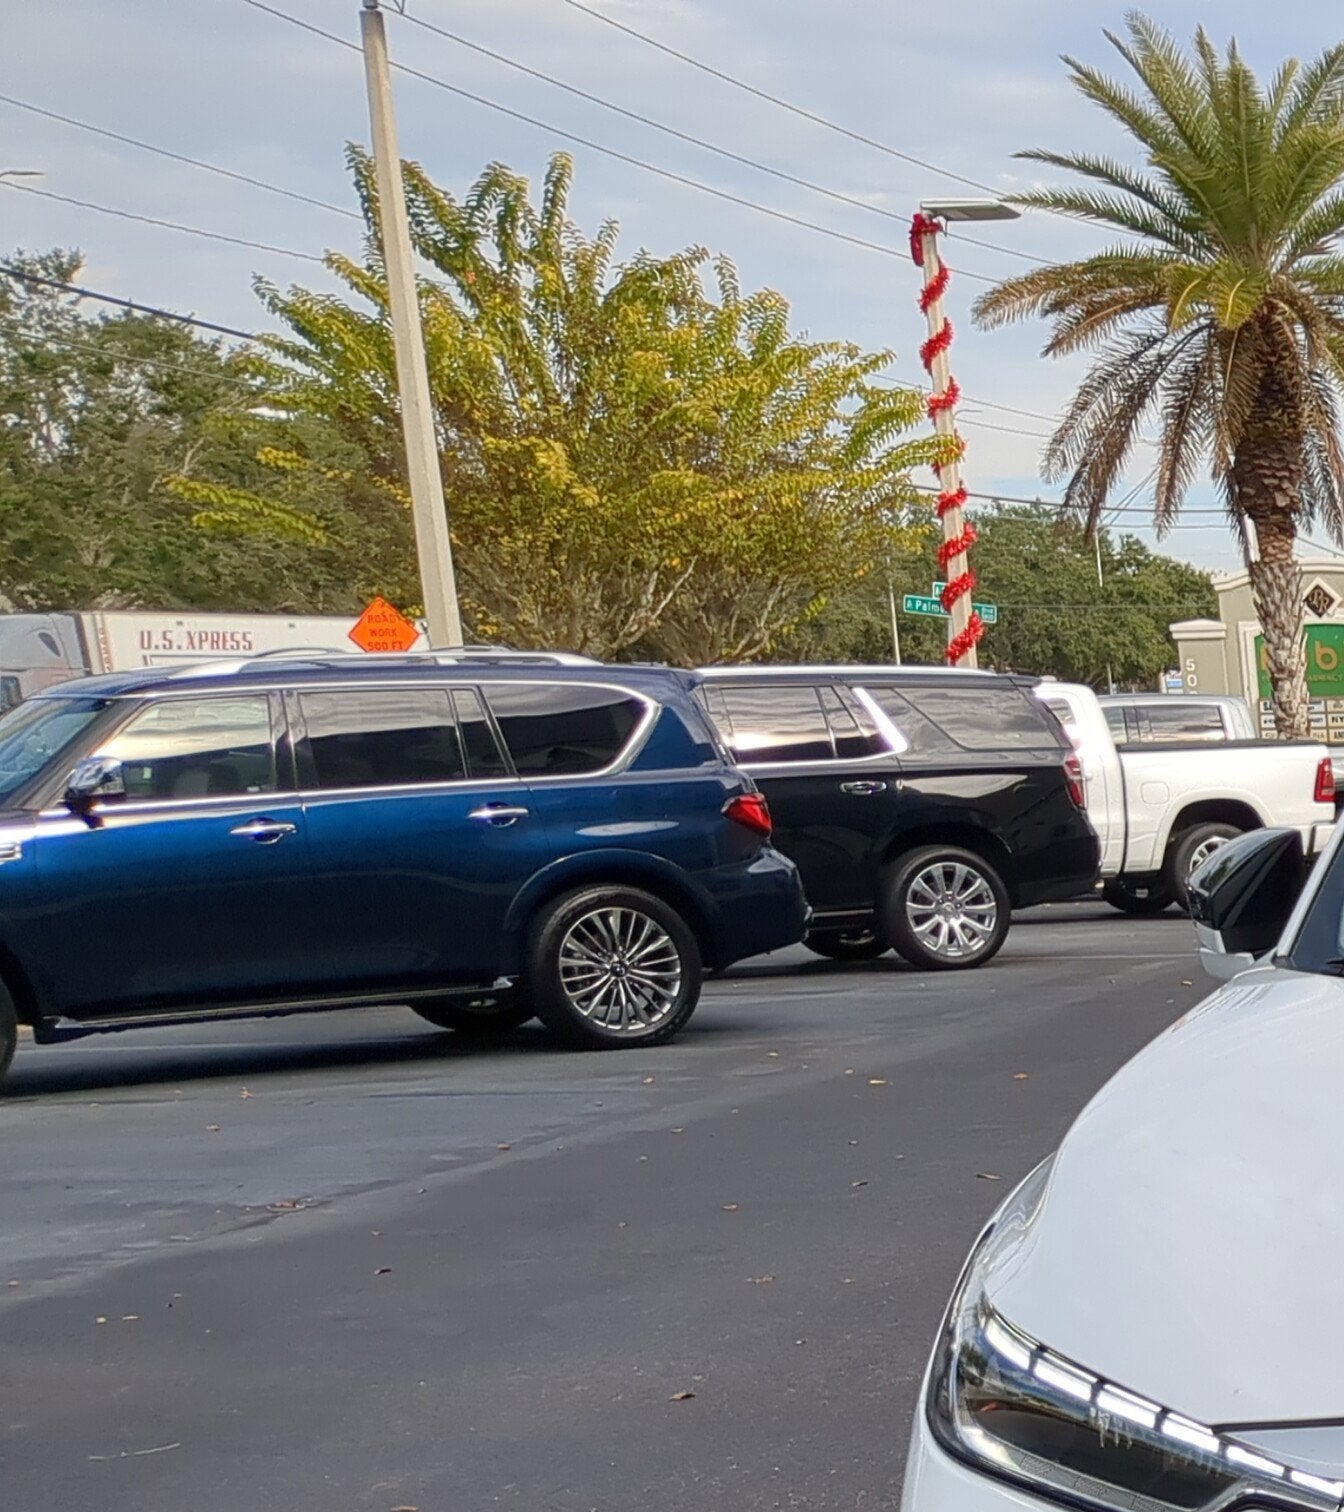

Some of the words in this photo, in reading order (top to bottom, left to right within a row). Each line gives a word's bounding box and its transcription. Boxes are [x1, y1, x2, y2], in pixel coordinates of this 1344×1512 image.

[368, 614, 397, 624] ROAD
[369, 628, 398, 637] WORK
[368, 641, 389, 651] 500
[391, 641, 403, 650] FT
[1185, 658, 1198, 695] 50
[1331, 714, 1344, 723] NY
